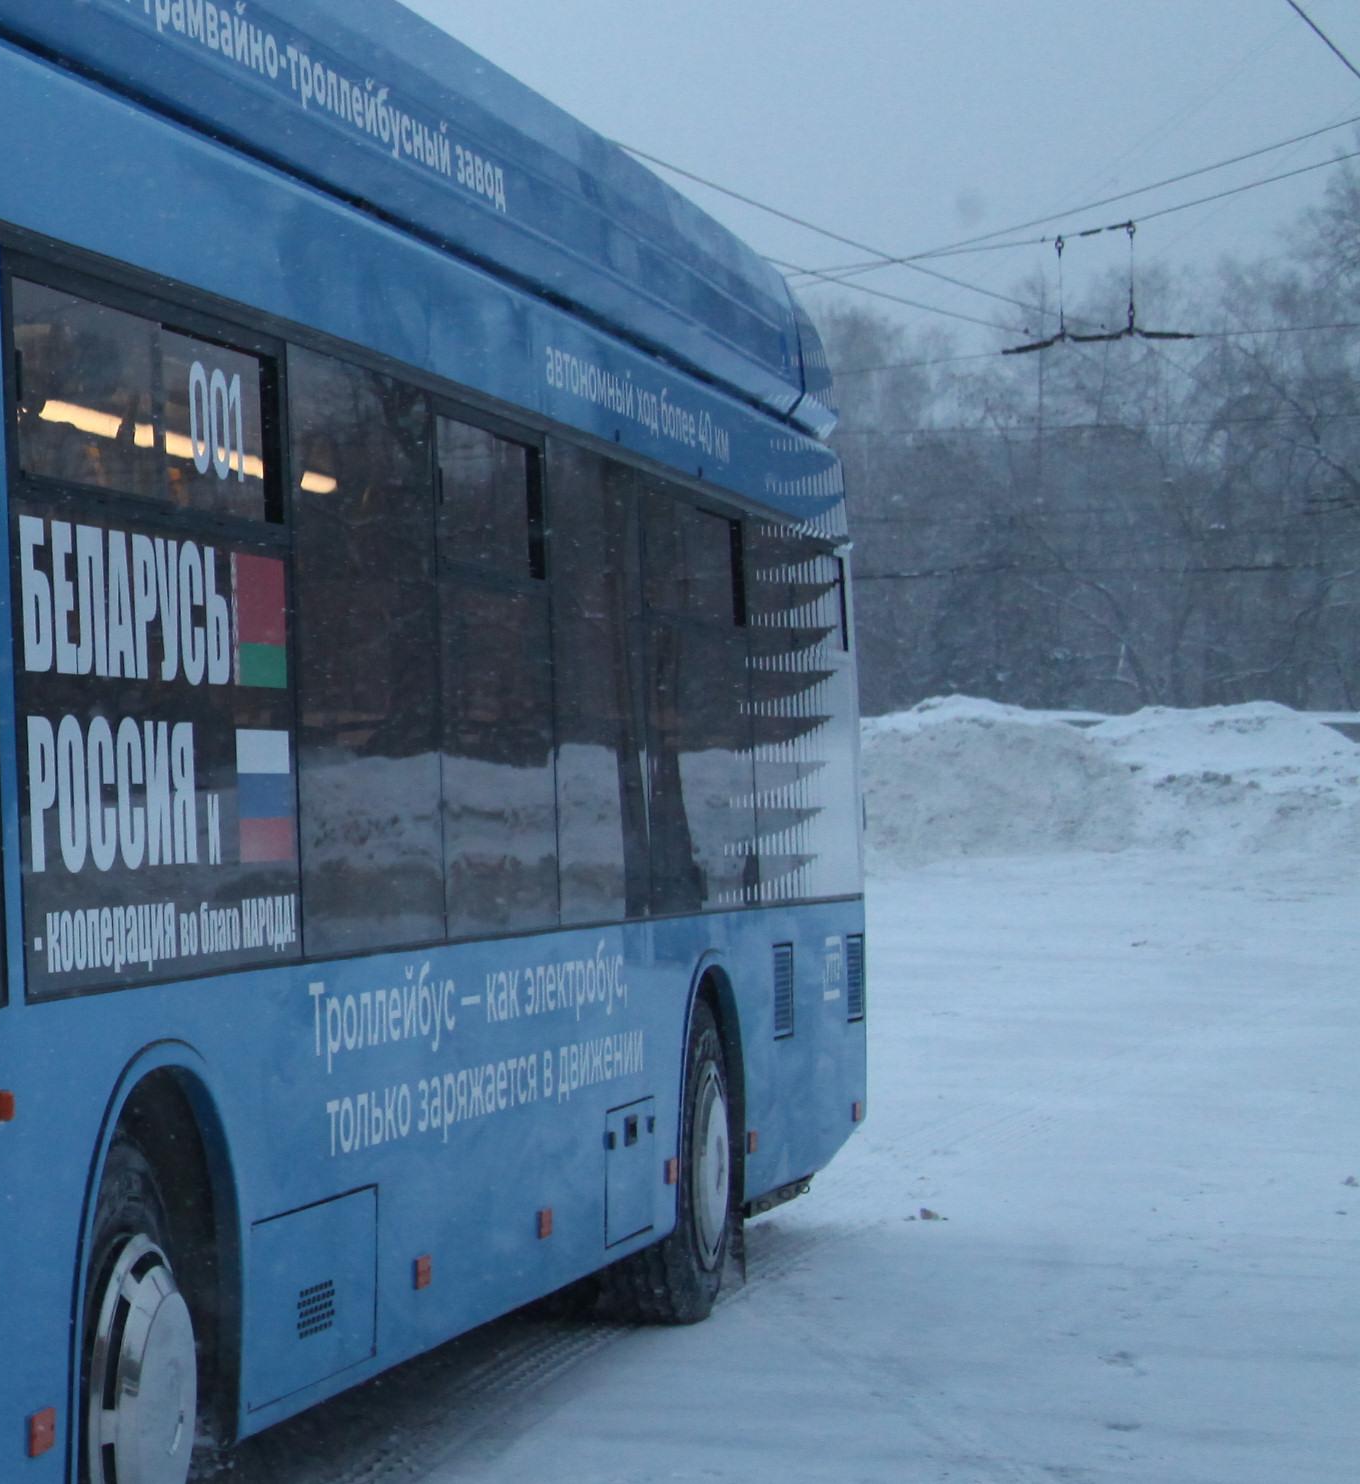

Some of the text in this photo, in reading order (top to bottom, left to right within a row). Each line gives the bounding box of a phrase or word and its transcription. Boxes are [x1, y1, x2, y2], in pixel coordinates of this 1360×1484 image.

[455, 144, 506, 213] завод
[188, 360, 245, 483] 001
[545, 346, 730, 464] автономный ход более 40 км
[18, 514, 231, 687] БЕЛАРУСЬ
[26, 713, 199, 874] РОССИЯ
[180, 911, 198, 957] во
[199, 901, 241, 954] благо
[241, 893, 296, 952] НАРОДА!
[308, 960, 456, 1075] Троллейбус
[486, 968, 521, 1024] как
[524, 937, 628, 1022] электробус,
[326, 1029, 644, 1157] только заряжается в движении
